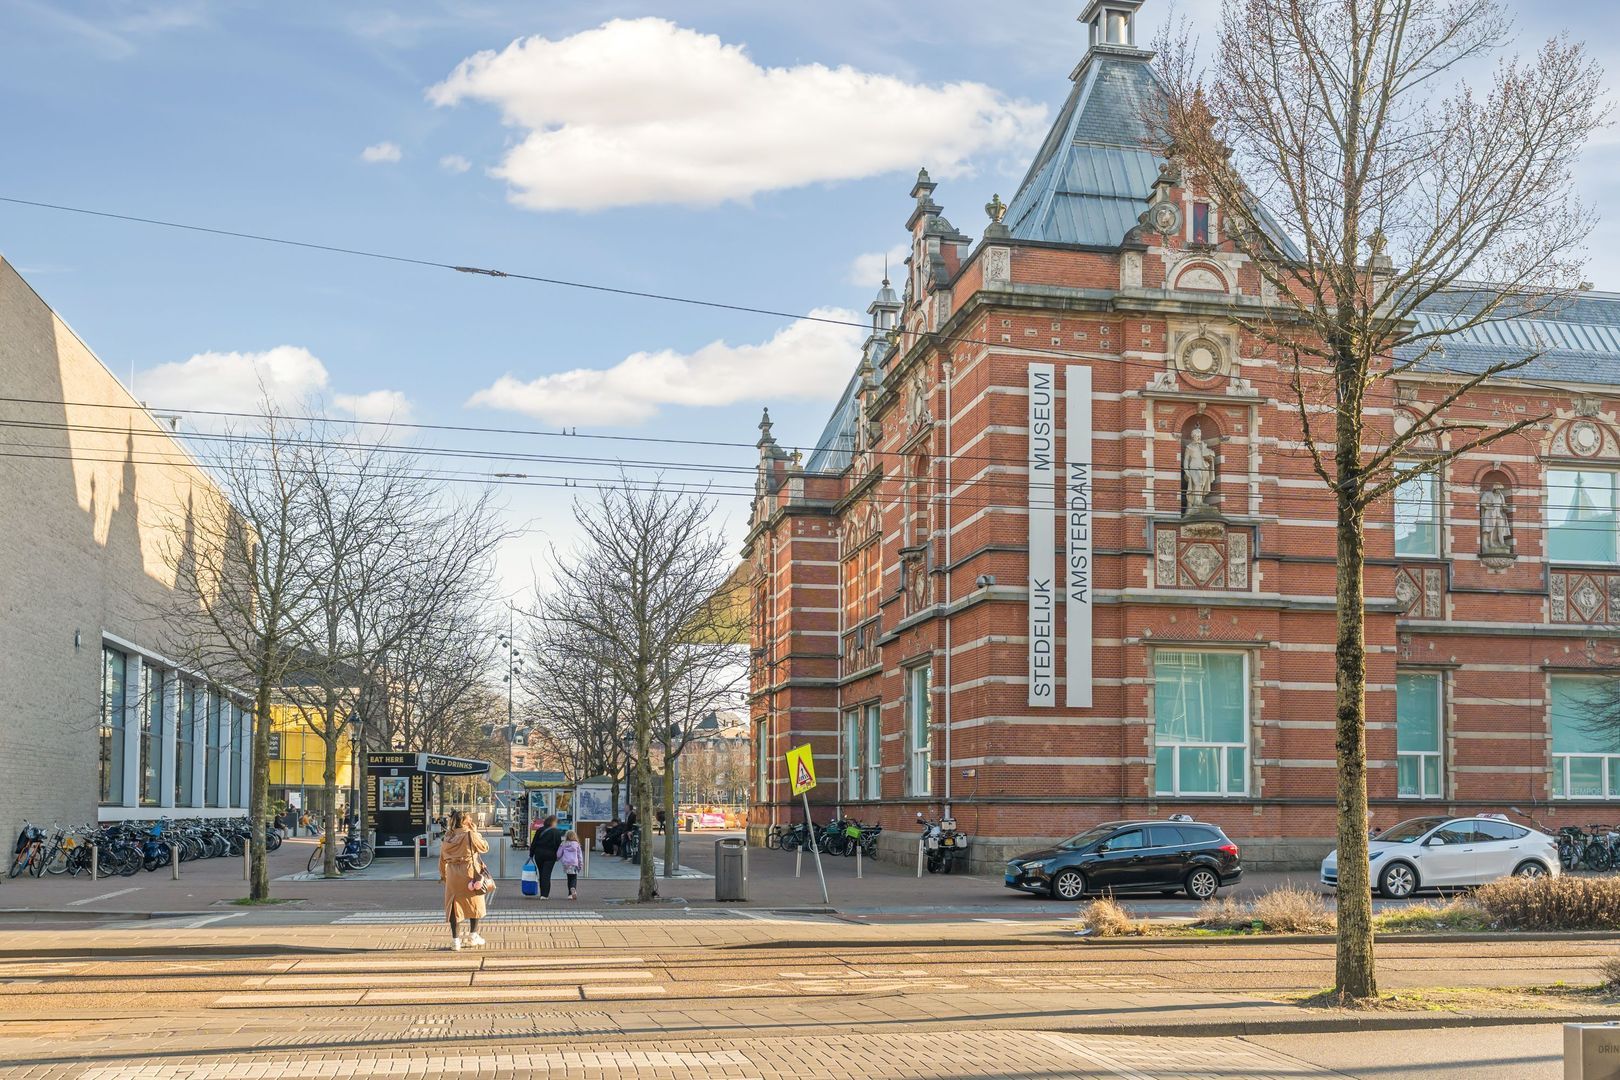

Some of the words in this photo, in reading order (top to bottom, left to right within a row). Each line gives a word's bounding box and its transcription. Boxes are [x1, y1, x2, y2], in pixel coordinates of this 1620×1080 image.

[1034, 372, 1051, 471] MUSEUM
[1071, 462, 1088, 604] AMSTERDAM
[1034, 578, 1051, 697] STEDELIJK
[412, 775, 423, 803] COFFEE
[427, 757, 447, 766] COLD
[447, 760, 473, 769] DRINKS
